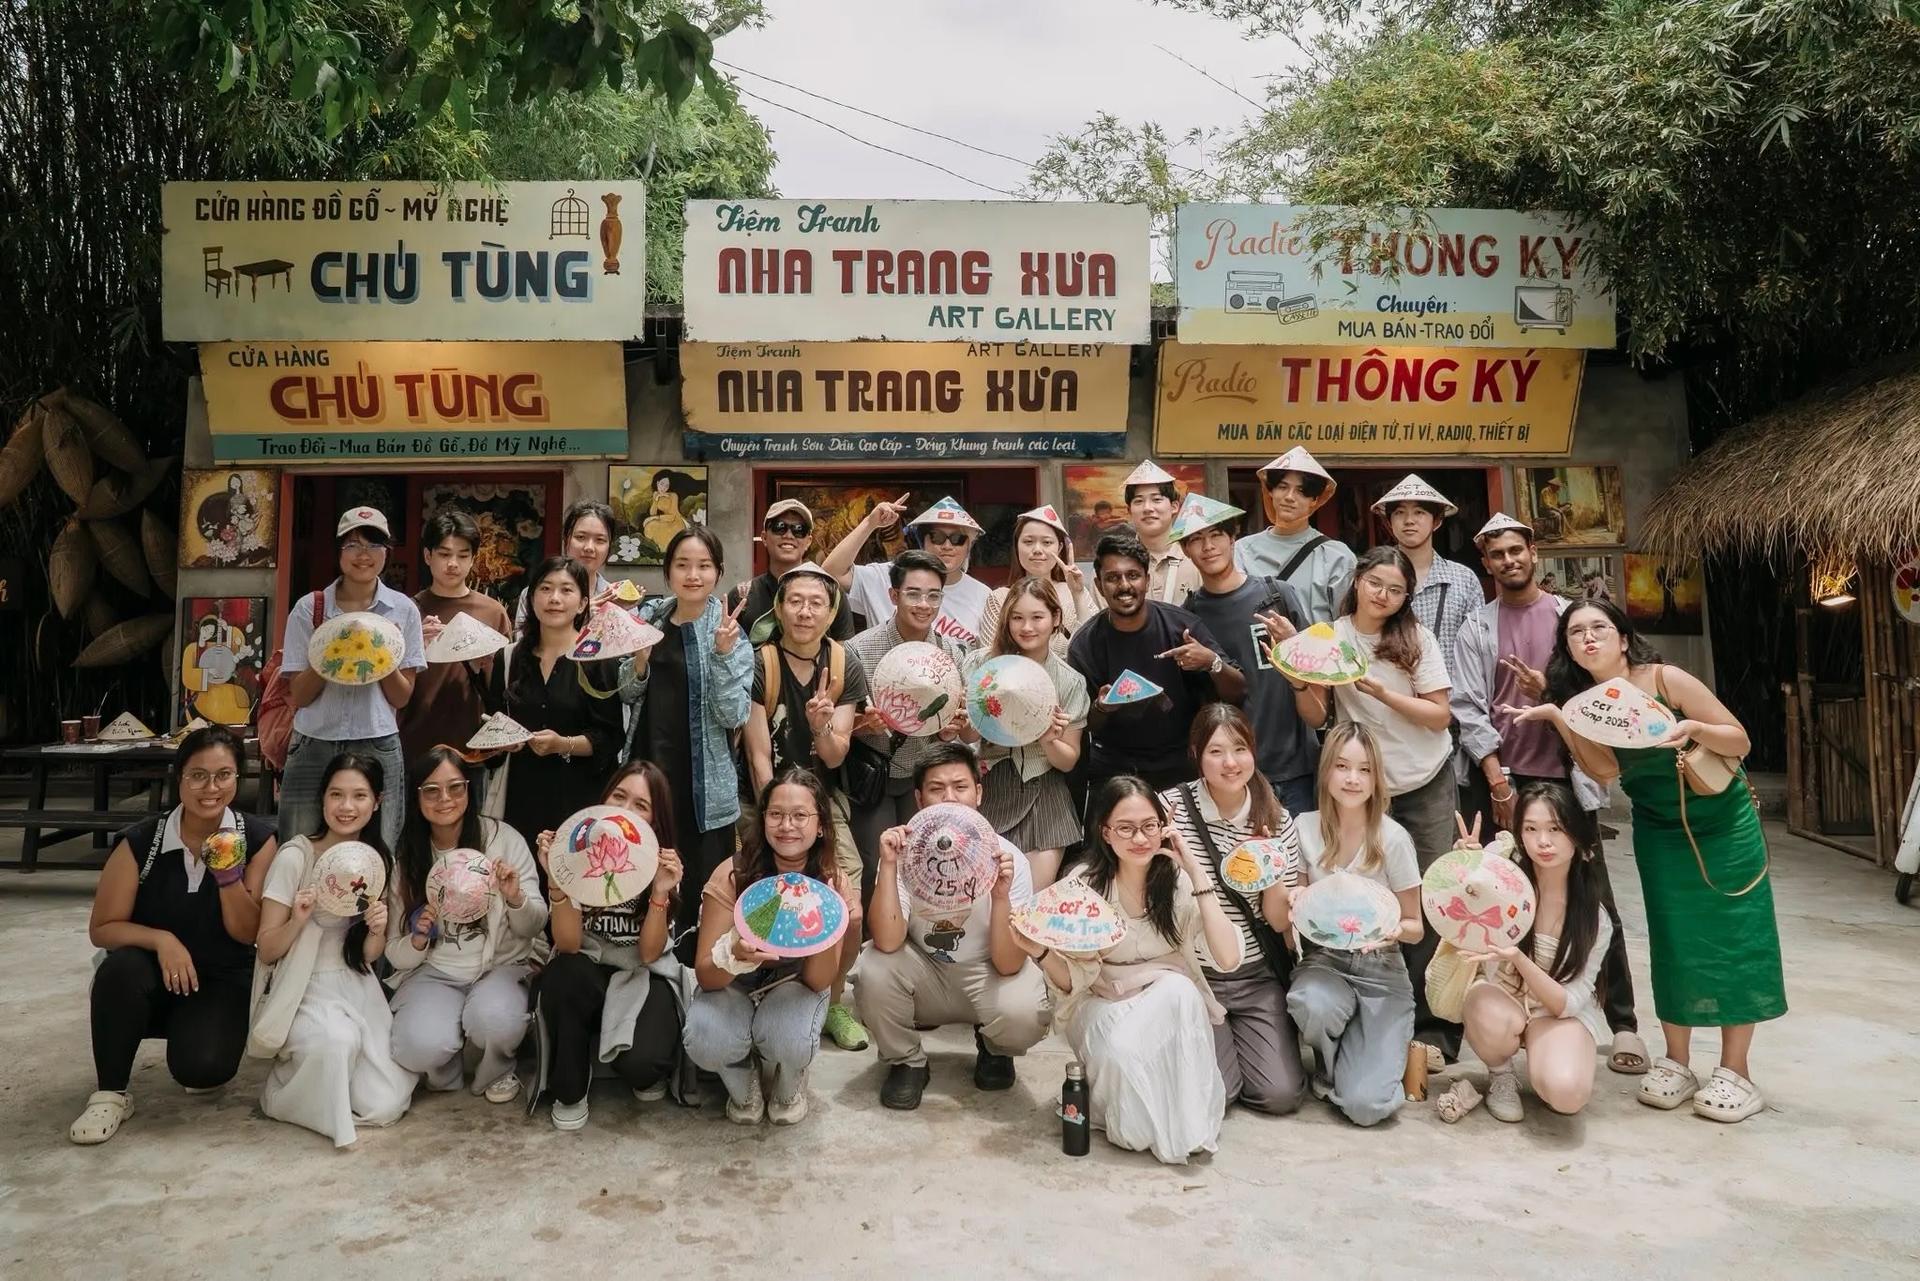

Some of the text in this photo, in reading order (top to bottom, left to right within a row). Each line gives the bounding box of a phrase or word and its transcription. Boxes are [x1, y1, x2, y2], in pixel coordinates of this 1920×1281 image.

[196, 190, 239, 221] CỬA
[247, 191, 305, 221] HÀNG
[312, 189, 342, 220] ĐỒ
[349, 187, 380, 221] GỖ
[403, 190, 438, 221] MỸ
[716, 204, 880, 236] Tiệm Tranh
[718, 248, 1116, 297] NHA TRANG XƯA
[1376, 294, 1447, 318] Chuyên
[928, 305, 1116, 331] ART GALLERY
[1339, 320, 1376, 338] MUA
[1384, 317, 1416, 338] BÁN
[228, 344, 330, 368] CỬA HÀNG
[716, 344, 801, 360] Tiệm Tranh
[967, 343, 1104, 357] ART GALLERY
[1167, 348, 1541, 403] Radio THÔNG KÝ
[717, 365, 1078, 413] NHA TRANG XƯA
[1217, 423, 1249, 440] MUA
[1256, 420, 1282, 440] BÁN
[257, 438, 297, 455] Trao
[376, 438, 406, 453] Bán
[496, 437, 520, 455] Mỹ
[951, 437, 988, 456] Khung
[992, 438, 1024, 450] tranh
[1592, 700, 1612, 712] CCT
[1580, 706, 1629, 728] Camp 2025
[926, 856, 959, 877] CCT
[934, 879, 957, 896] 25
